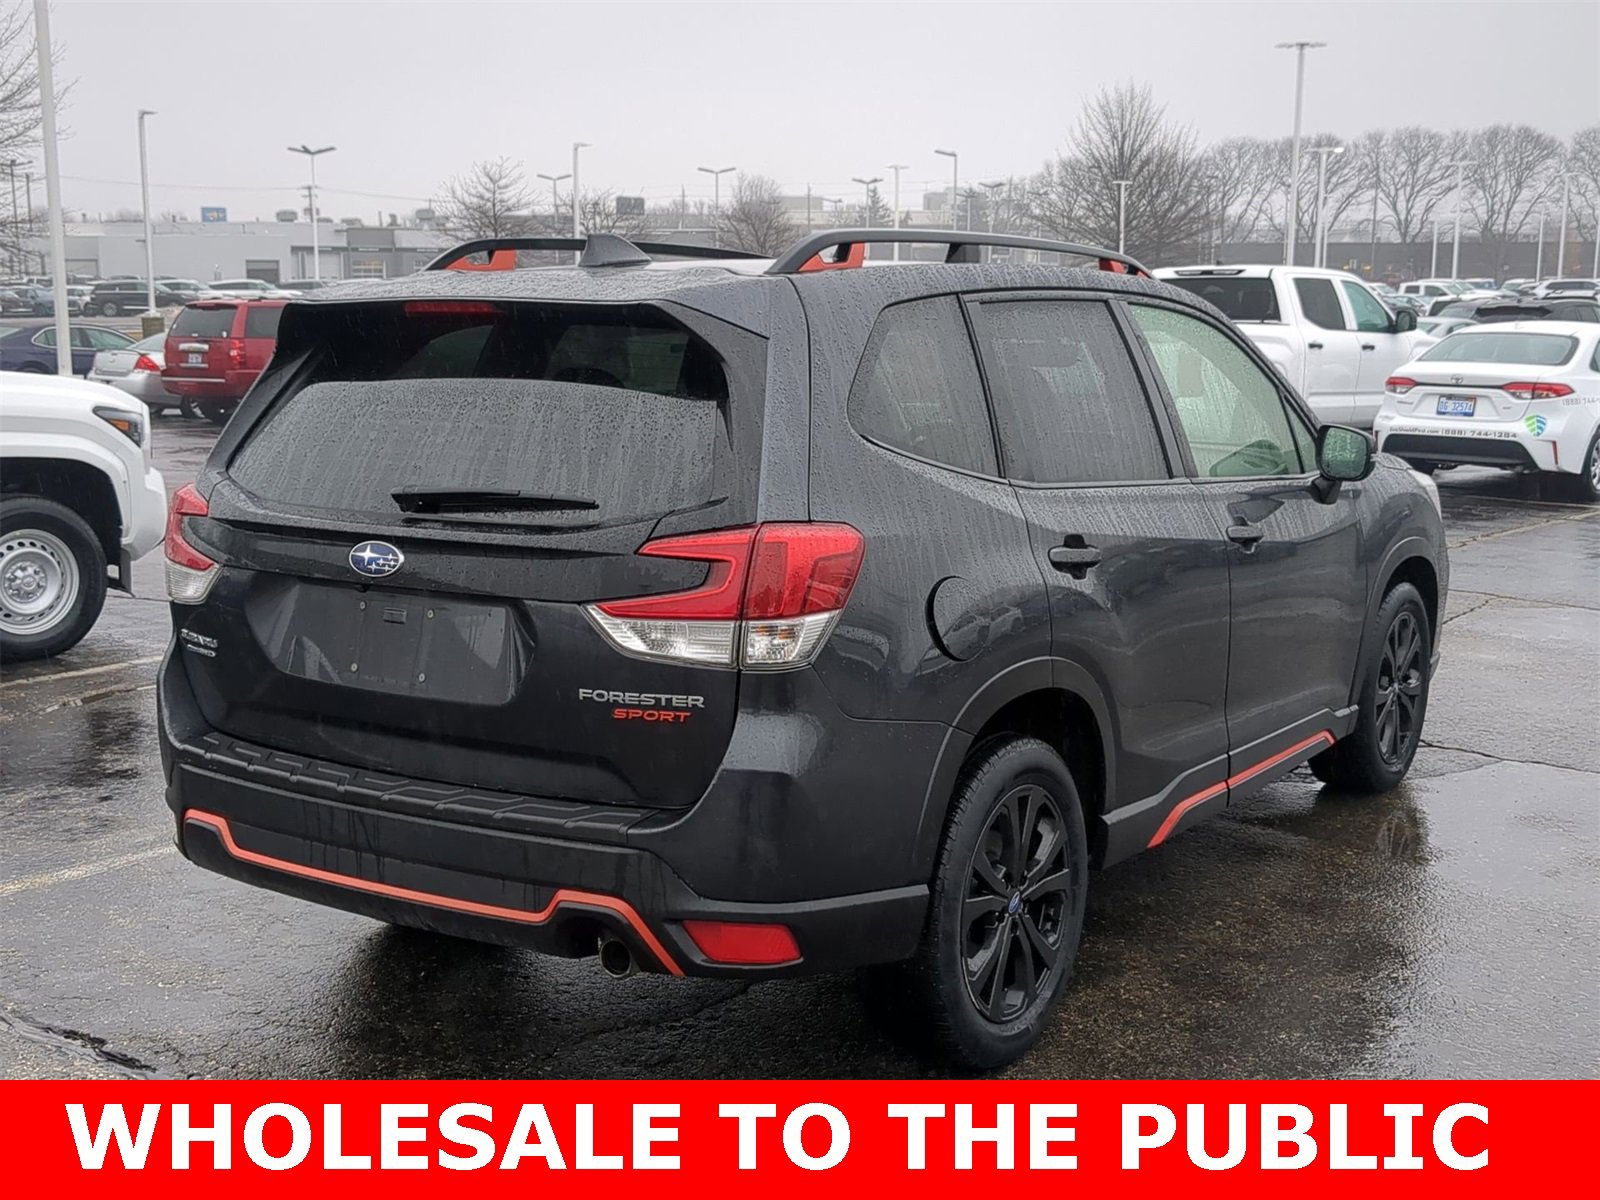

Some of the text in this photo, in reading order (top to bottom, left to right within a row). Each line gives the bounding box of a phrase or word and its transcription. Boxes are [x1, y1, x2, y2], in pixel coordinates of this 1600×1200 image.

[1441, 428, 1466, 436] (888)
[1470, 430, 1517, 438] 744-1284
[578, 688, 705, 708] FORESTER
[612, 708, 692, 723] SPORT
